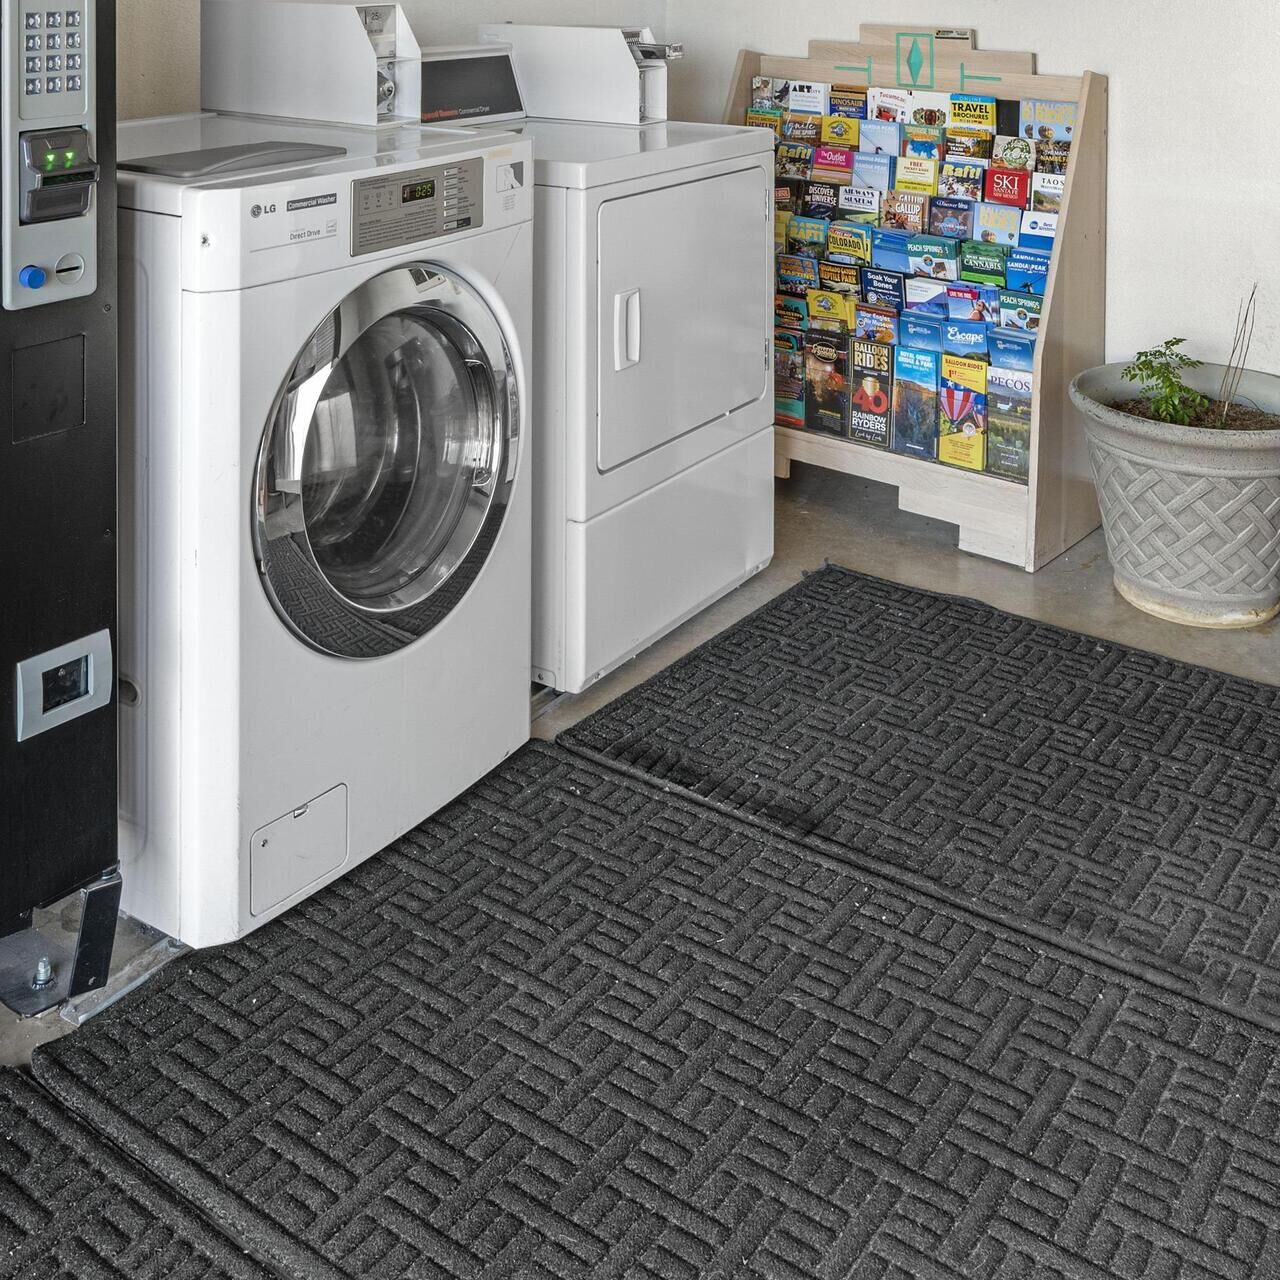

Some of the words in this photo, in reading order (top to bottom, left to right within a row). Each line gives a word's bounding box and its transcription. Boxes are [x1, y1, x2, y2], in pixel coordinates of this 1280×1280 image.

[831, 98, 864, 107] DINOSAUR
[952, 102, 990, 114] TRAVEL
[953, 112, 989, 121] BROCHURES
[778, 144, 813, 160] Raft!
[826, 151, 846, 162] Outlet
[943, 164, 982, 179] Raft!
[993, 174, 1019, 190] SKI
[808, 185, 835, 196] DISCOVER
[288, 200, 317, 210] Commercial
[811, 194, 837, 206] UNIVERSE
[895, 202, 921, 215] GALLUP
[289, 231, 306, 241] Direct
[828, 235, 862, 250] COLORADO
[963, 258, 1002, 271] CANNABIS
[1007, 261, 1028, 269] SANDIA
[1030, 264, 1046, 272] PEAK
[867, 272, 883, 281] Soak
[883, 275, 898, 284] Your
[873, 280, 893, 290] Bones
[1000, 295, 1018, 304] PEACH
[947, 326, 984, 344] Escape
[855, 341, 889, 356] BALLOON
[854, 353, 889, 371] RIDES
[990, 375, 1031, 392] PECOS
[852, 385, 889, 414] 40
[852, 410, 887, 424] RAINBOW
[851, 418, 887, 432] RYDERS
